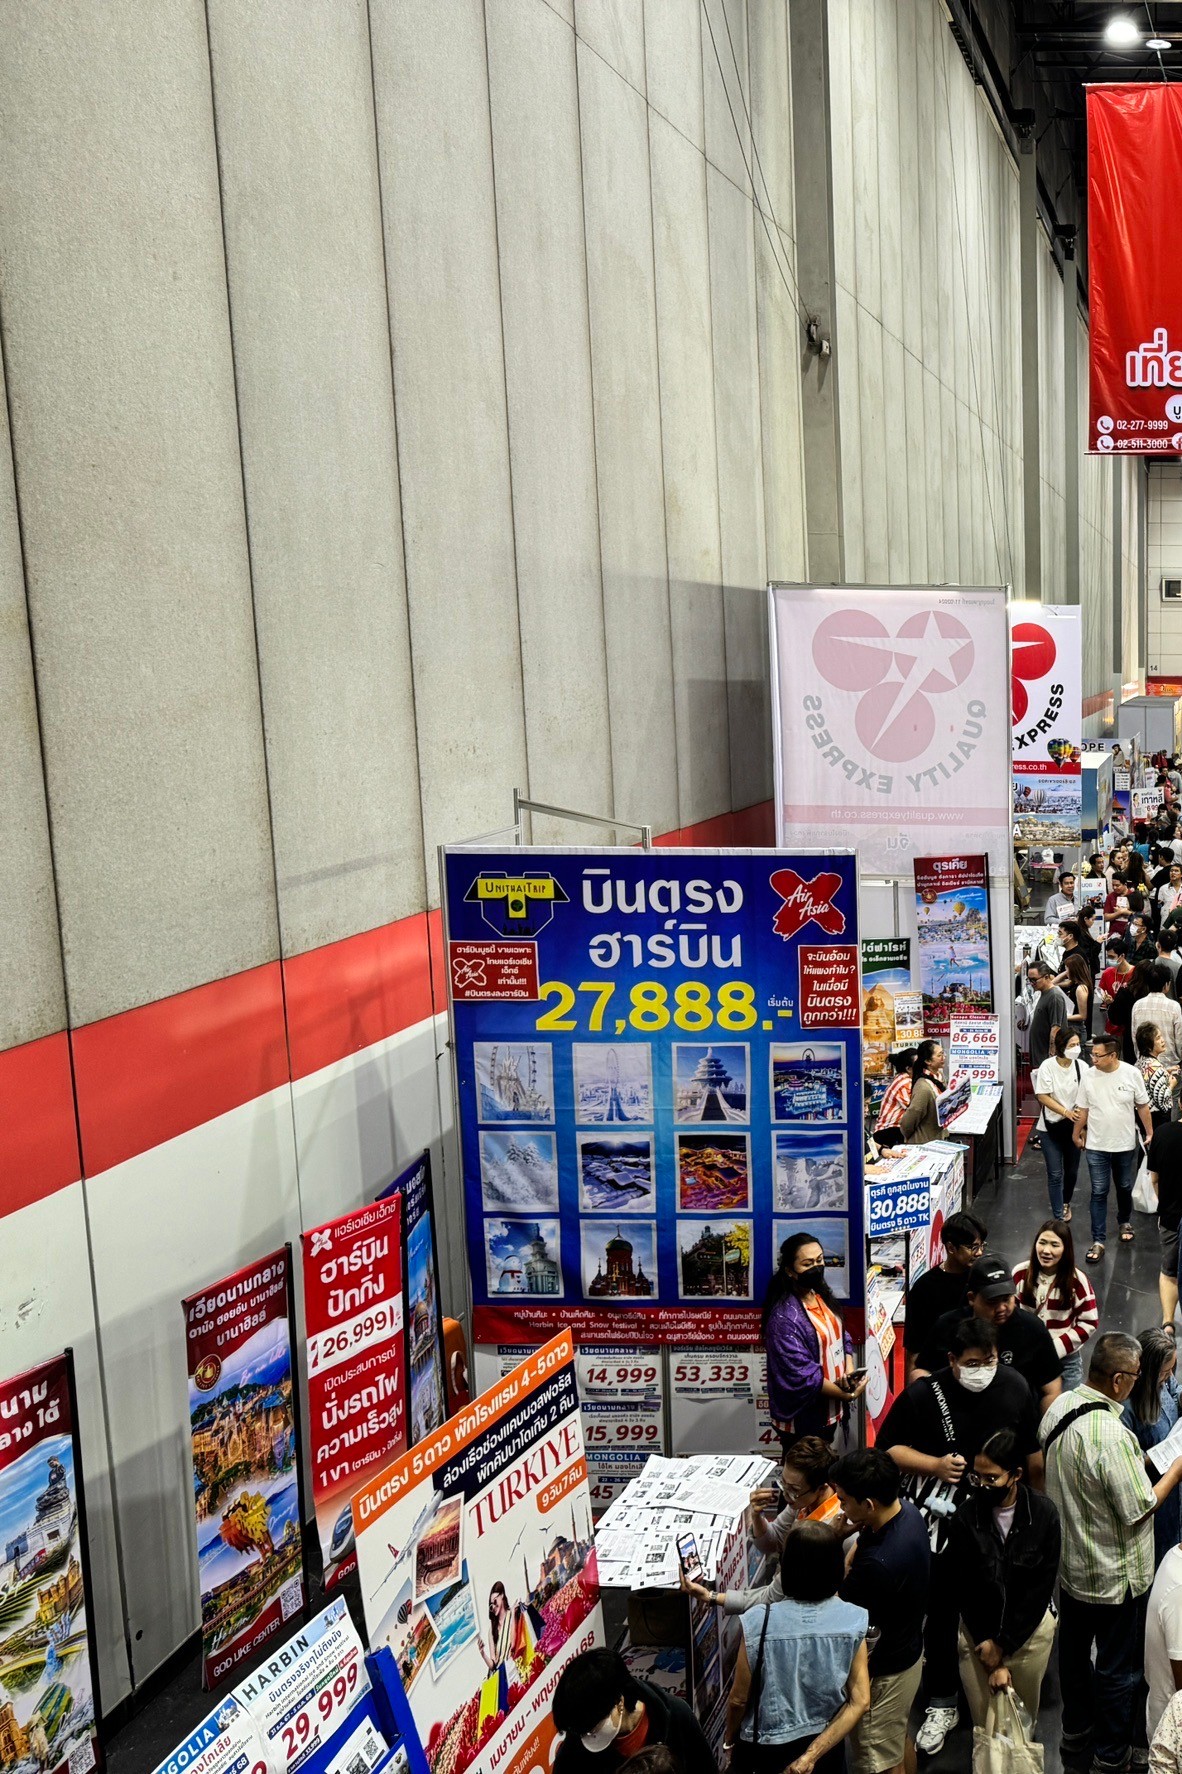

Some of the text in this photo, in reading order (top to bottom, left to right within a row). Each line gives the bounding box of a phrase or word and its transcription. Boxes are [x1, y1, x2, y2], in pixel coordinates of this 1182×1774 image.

[1117, 420, 1168, 430] 02-277-9999
[1117, 439, 1168, 449] 02-511-3000
[582, 868, 744, 914] บินตรง
[787, 884, 811, 907] Air
[799, 897, 830, 920] Asia
[588, 919, 742, 969] ฮาร์บิน
[806, 950, 850, 961] จะบินอ้อม
[812, 979, 848, 991] ในเมื่อมี
[767, 994, 794, 1007] เริ่มต้น
[807, 994, 852, 1007] บินตรง
[952, 1033, 997, 1044] 86,666
[871, 1192, 930, 1220] 30,888
[897, 1217, 903, 1226] 5
[904, 1216, 917, 1225] ดาว
[918, 1213, 929, 1222] TK
[189, 1260, 285, 1323] เวียดนามกลาง
[327, 1266, 385, 1318] ปักกิ่ง
[586, 1367, 657, 1386] 14,999
[674, 1365, 750, 1385] 53,333
[322, 1367, 399, 1430] นั่งรถไฟ
[37, 1398, 60, 1428] ใต้
[317, 1399, 403, 1464] ความเร็วสูง
[443, 1372, 573, 1488] ล่องเรือช่องแคบบอสฟอรัส
[476, 1393, 575, 1484] พักคัปปาโดเกีย 2 คืน
[585, 1425, 658, 1444] 15,999
[359, 1468, 409, 1520] บินตรง
[454, 1383, 519, 1442] พักโรงแรม
[469, 1420, 581, 1539] TURKIYE
[338, 1562, 356, 1580] GOD
[213, 1658, 233, 1678] GOD
[234, 1645, 252, 1663] LIKE
[252, 1617, 281, 1646] CENTER
[580, 1630, 595, 1651] 68
[241, 1634, 310, 1701] HARBIN
[282, 1662, 357, 1760] 29,999
